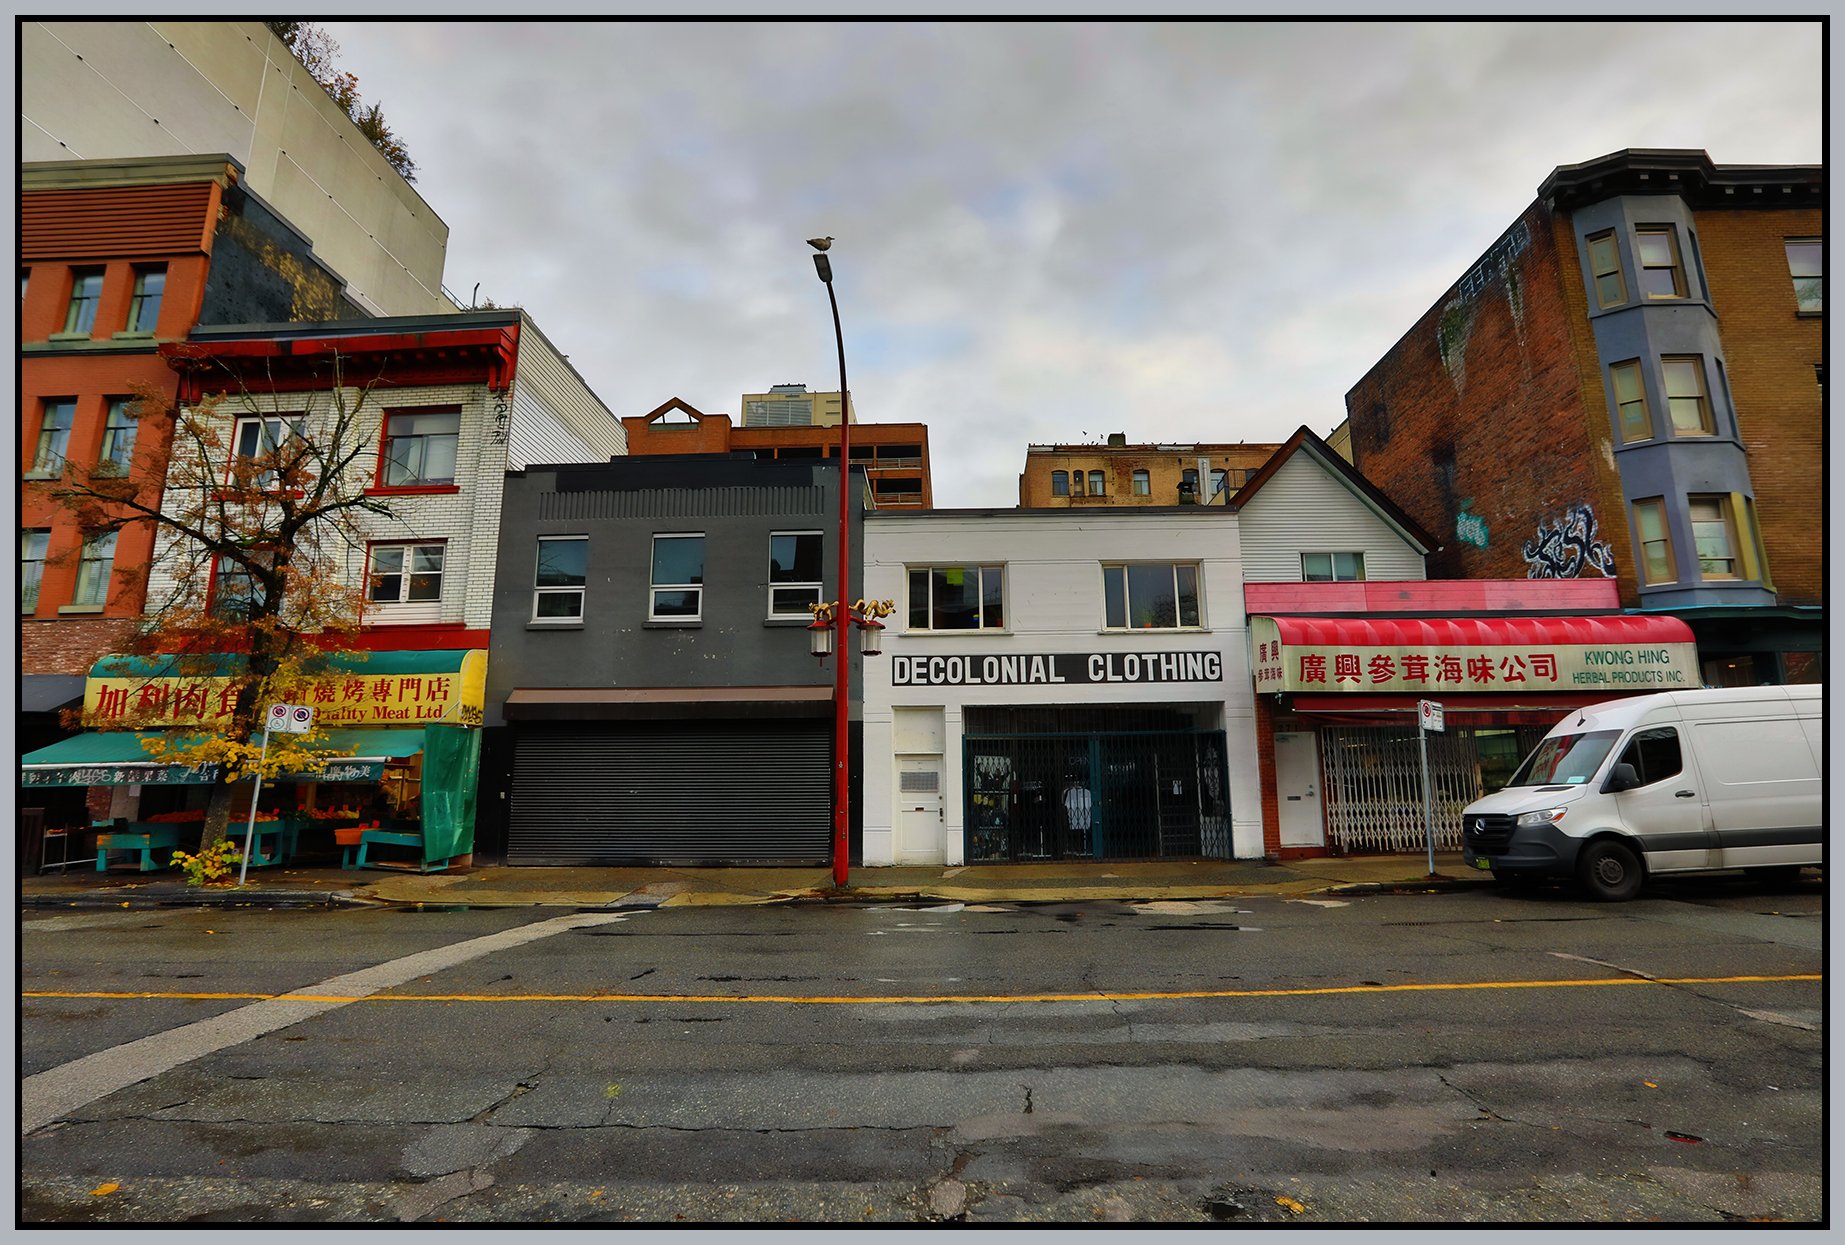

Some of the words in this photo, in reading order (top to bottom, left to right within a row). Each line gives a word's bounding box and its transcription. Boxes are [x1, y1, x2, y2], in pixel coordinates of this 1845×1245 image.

[1260, 639, 1279, 663] 廣興
[1584, 650, 1634, 666] KWONG
[1637, 649, 1670, 665] HING
[894, 655, 1066, 684] DECOLONIAL
[1087, 652, 1221, 683] CLOTHING
[1299, 652, 1558, 684] 廣興參茸海味公司
[1572, 672, 1611, 684] HERBAL
[1612, 670, 1663, 684] PRODUCTS
[1665, 670, 1686, 683] INC.
[372, 704, 409, 720] Meat
